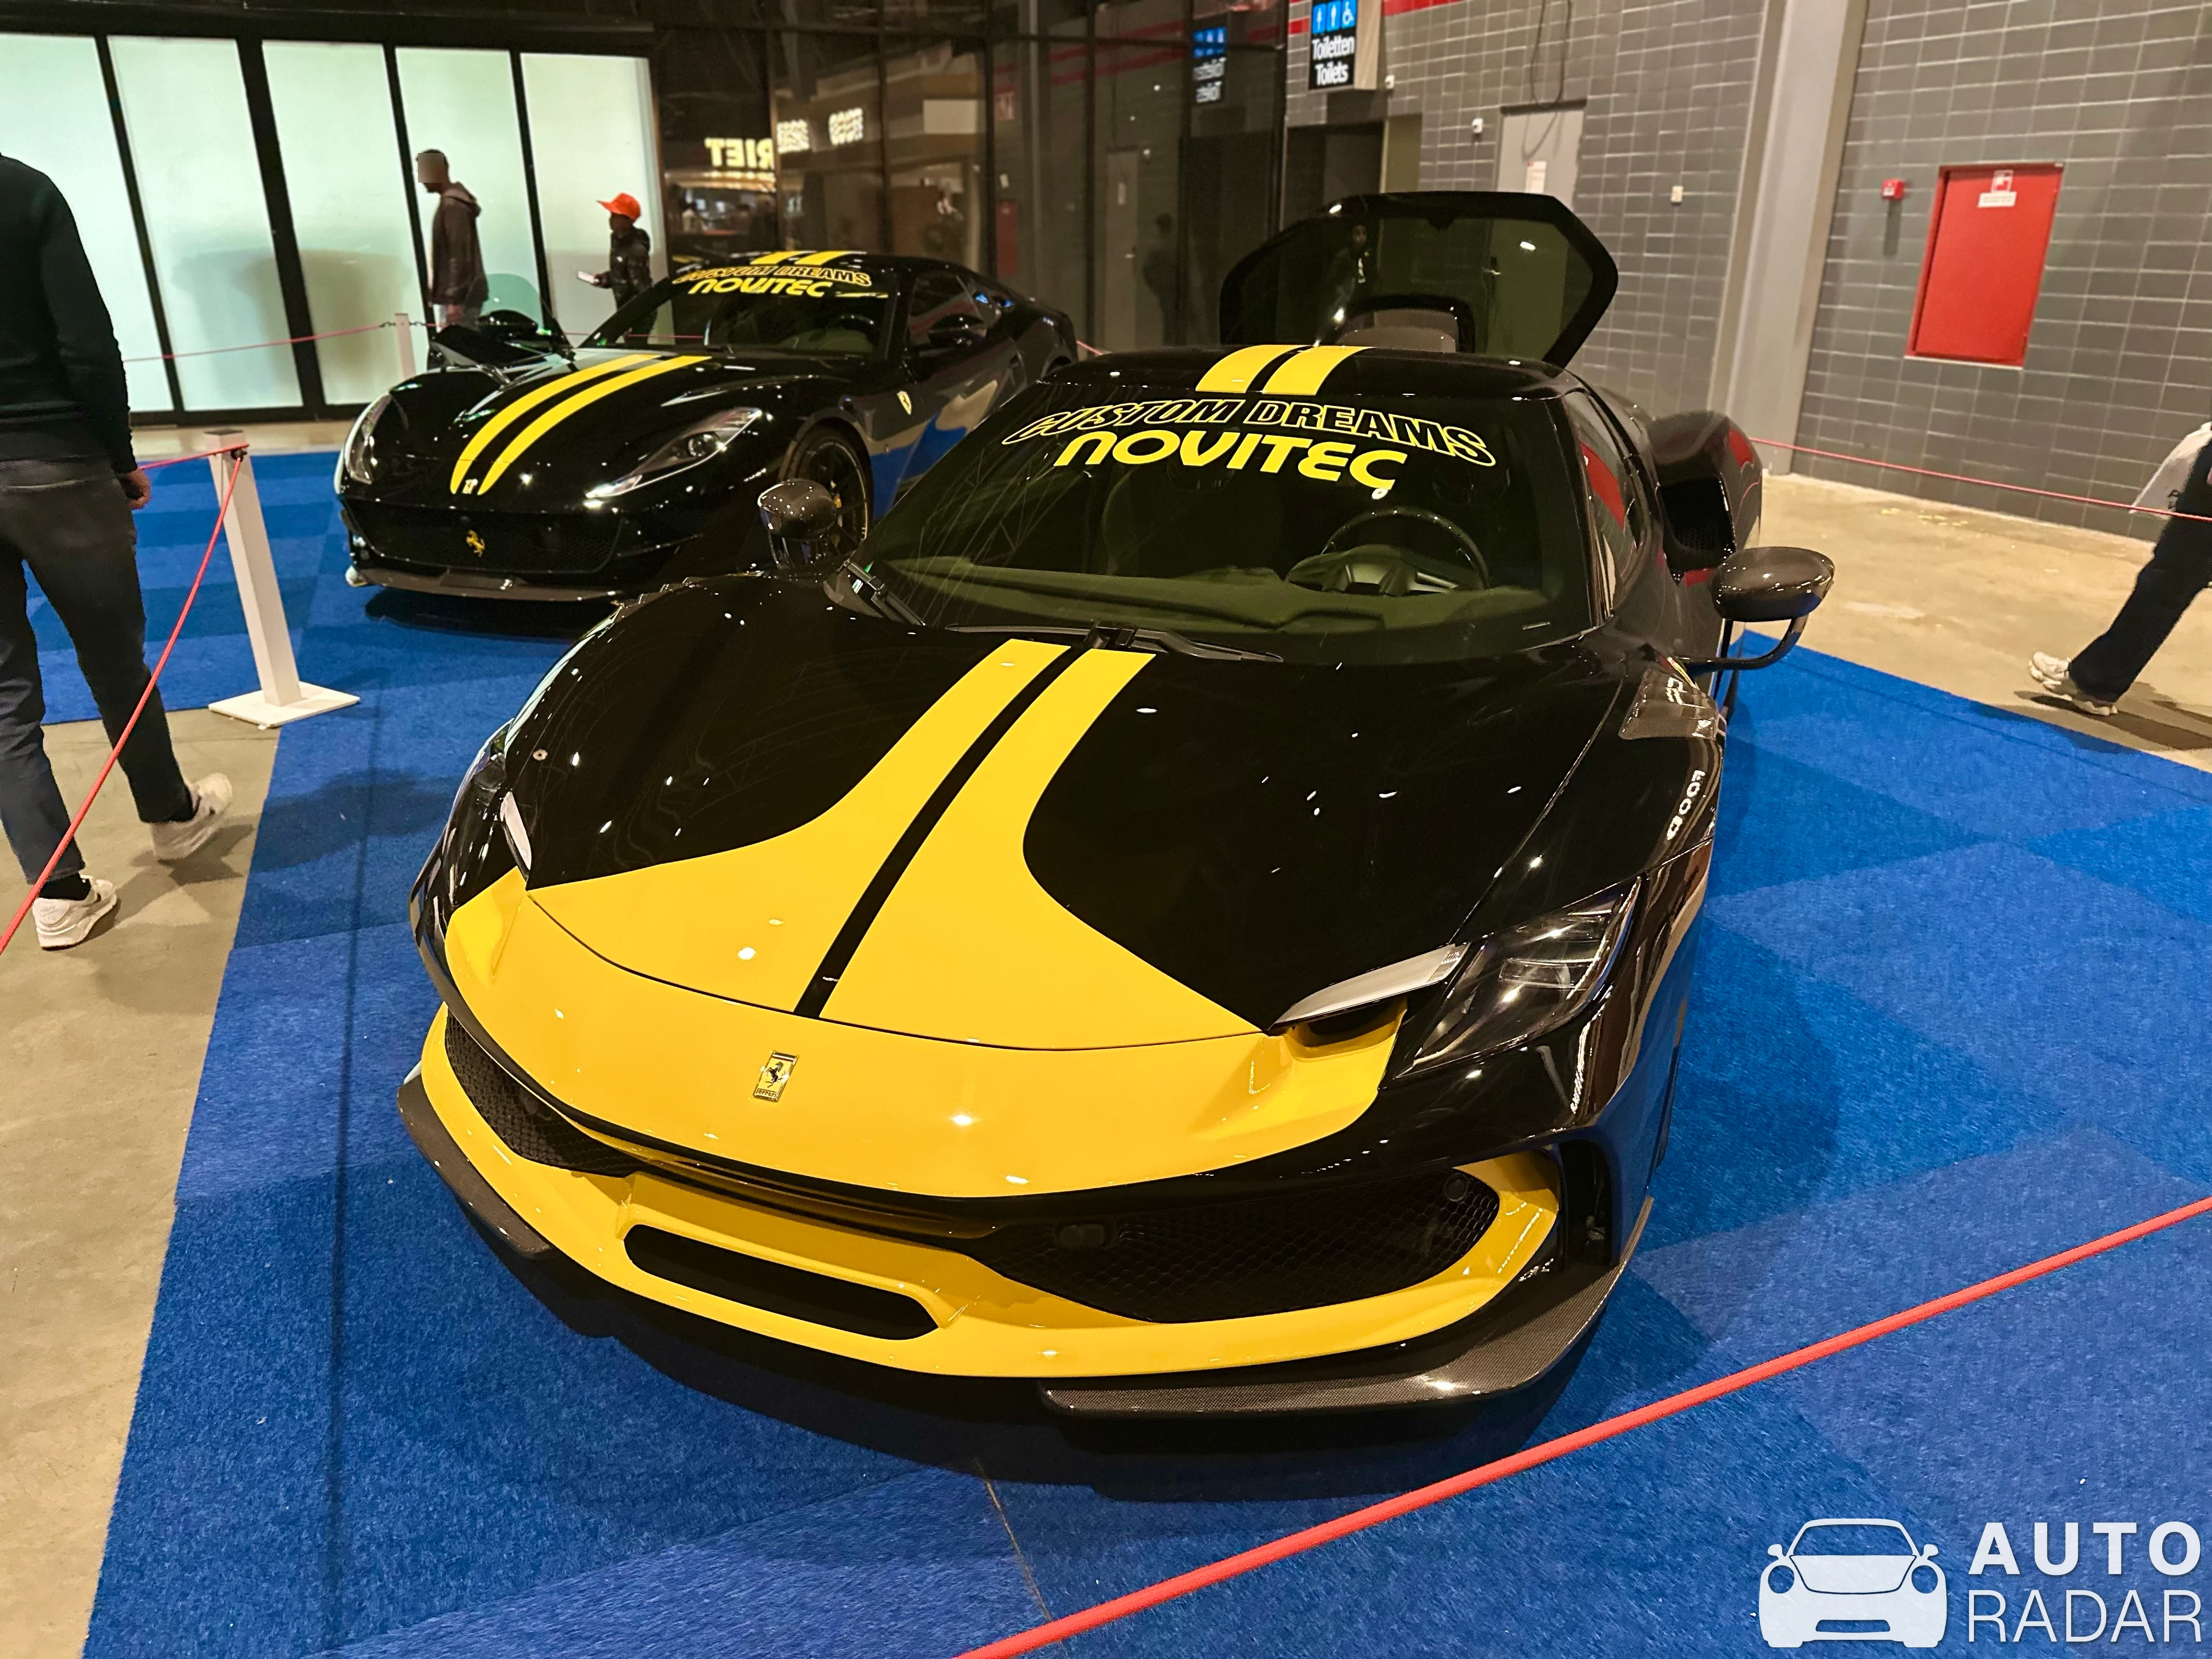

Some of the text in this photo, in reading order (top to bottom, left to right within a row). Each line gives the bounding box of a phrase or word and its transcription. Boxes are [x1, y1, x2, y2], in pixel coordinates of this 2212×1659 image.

[1311, 35, 1355, 61] Toiletten
[1315, 61, 1349, 85] Toilets
[774, 266, 872, 286] DREAMS
[1002, 399, 1496, 467] CUSTOM DREAMS
[1053, 430, 1408, 492] NOVITEC
[755, 1088, 778, 1098] Ferrari
